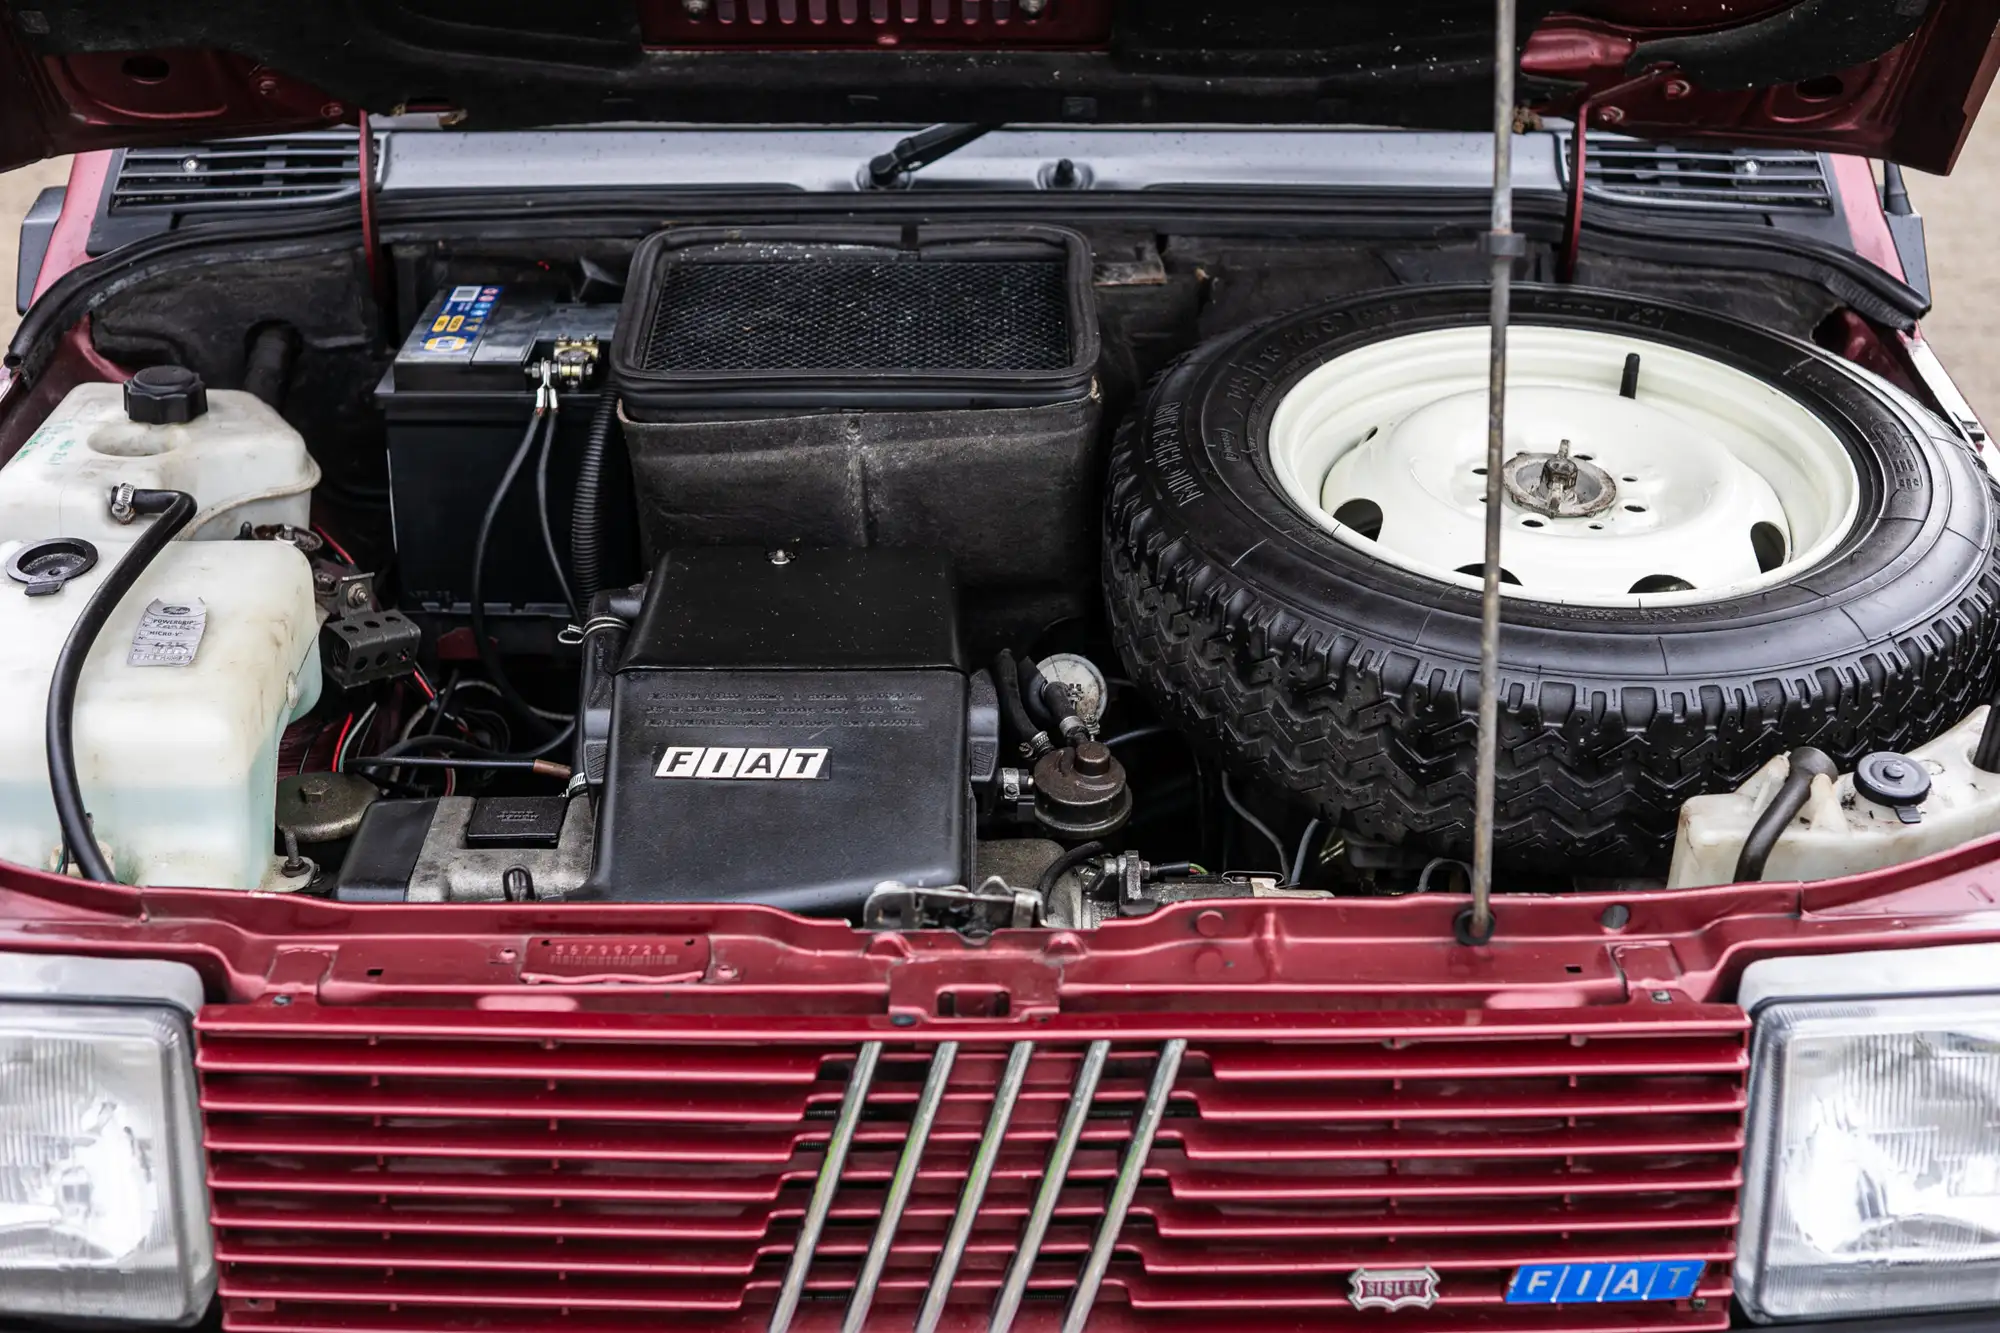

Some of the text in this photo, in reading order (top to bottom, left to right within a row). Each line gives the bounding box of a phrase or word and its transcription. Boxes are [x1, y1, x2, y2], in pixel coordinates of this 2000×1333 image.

[666, 751, 819, 774] FIAT
[1365, 1279, 1423, 1298] SISLEY
[1527, 1266, 1690, 1296] FIAT
